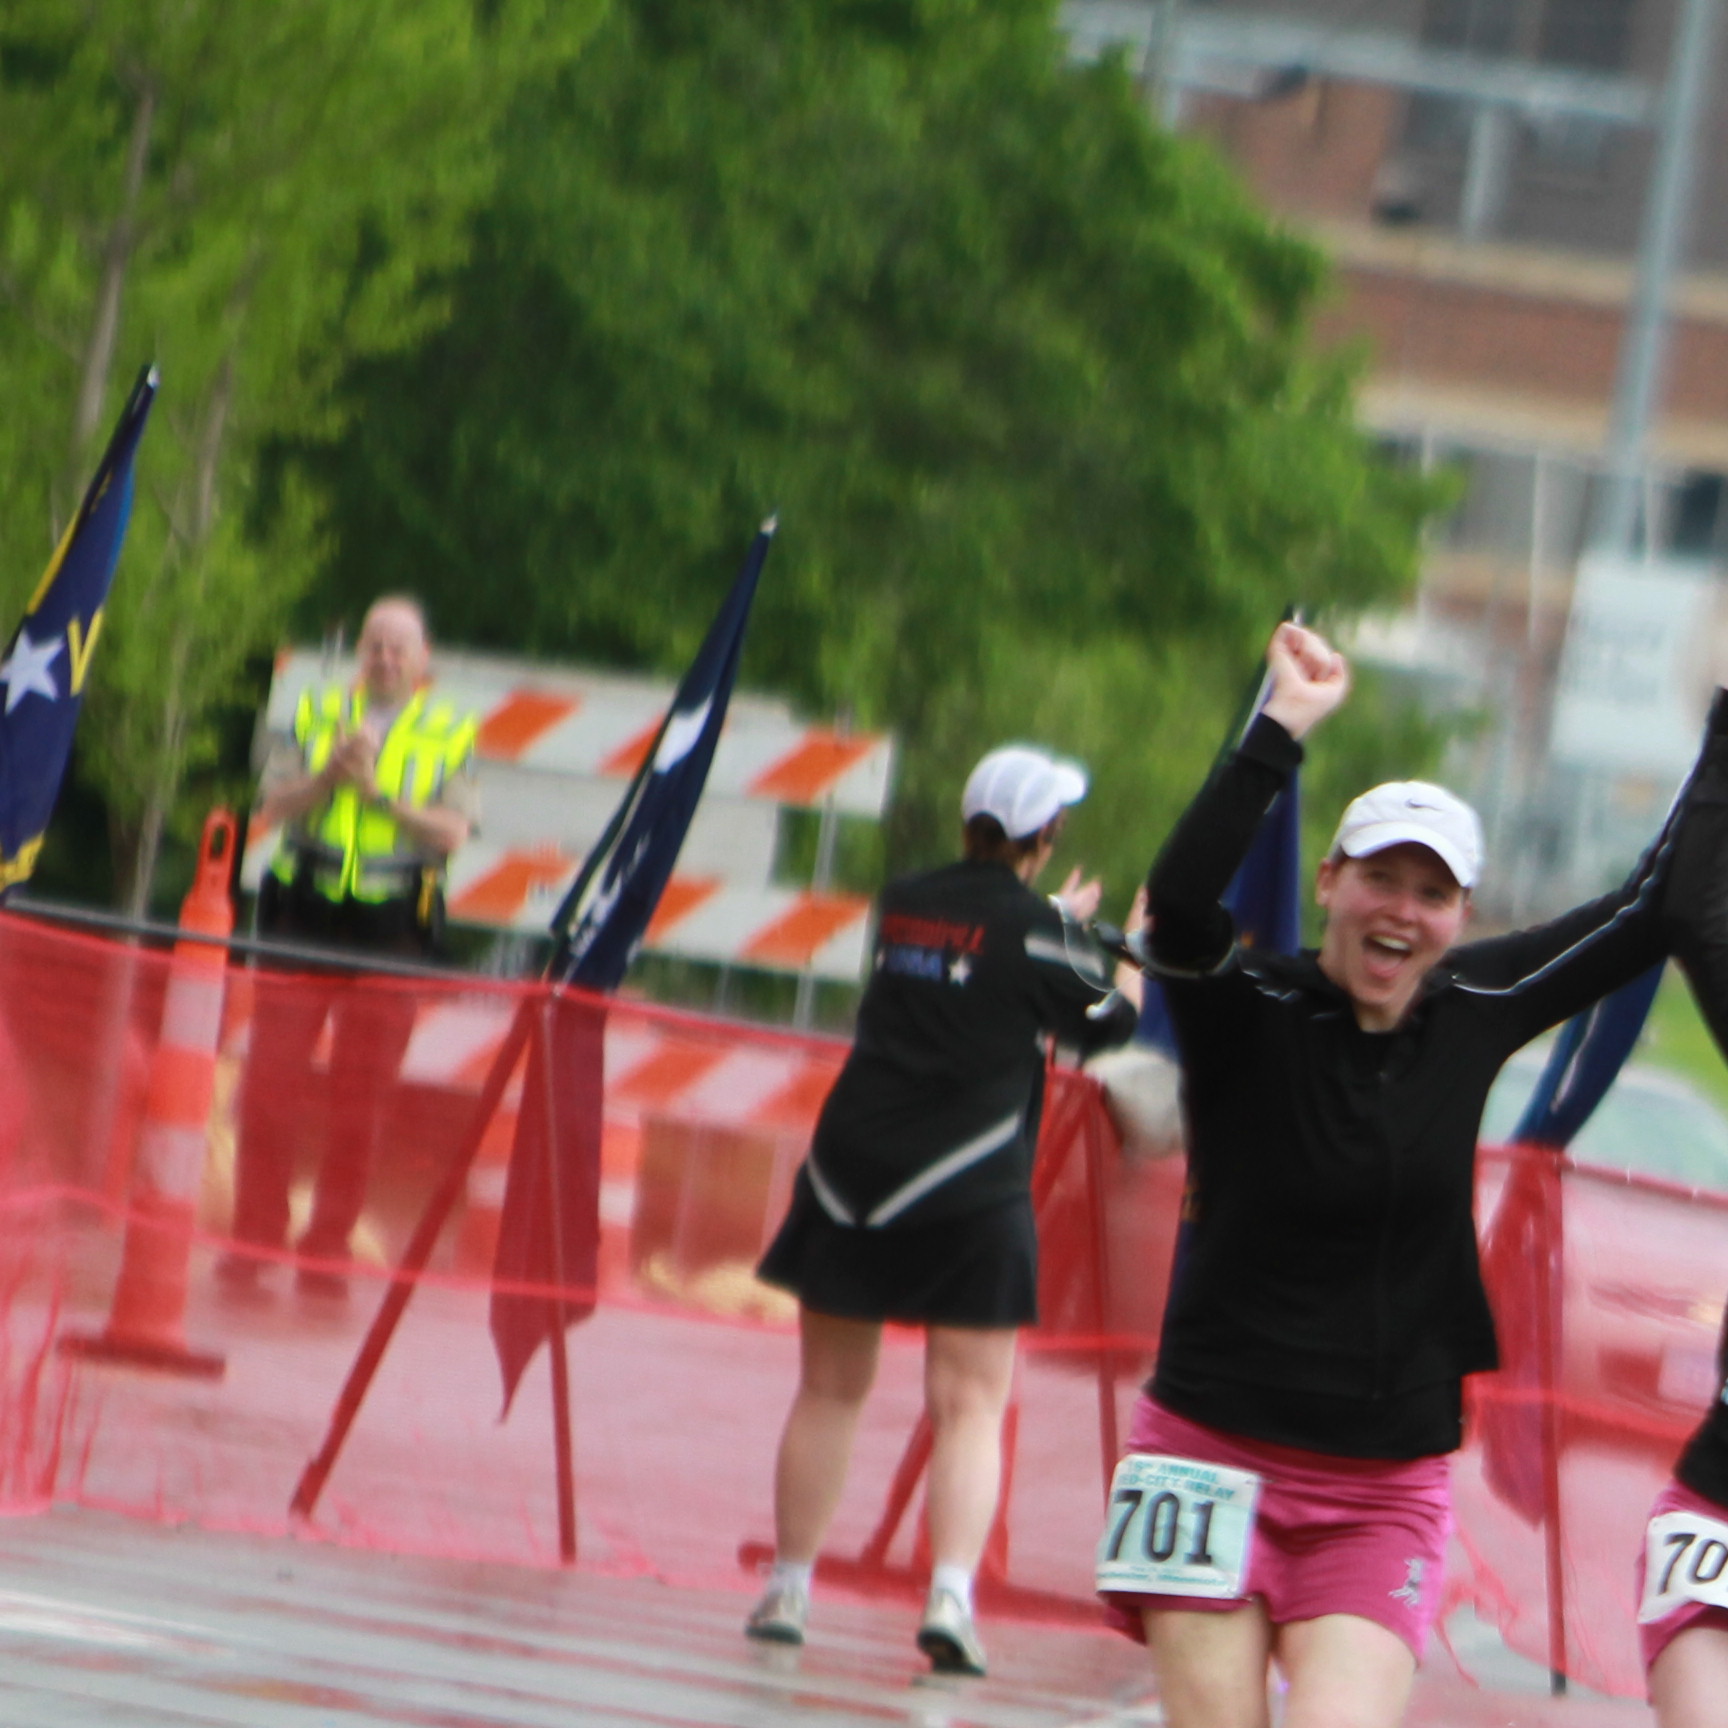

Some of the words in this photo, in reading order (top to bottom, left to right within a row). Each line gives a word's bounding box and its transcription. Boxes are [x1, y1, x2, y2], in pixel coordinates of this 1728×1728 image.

[1159, 1463, 1218, 1483] ANNUAL
[1184, 1480, 1236, 1500] RELAY
[1104, 1489, 1216, 1566] 701
